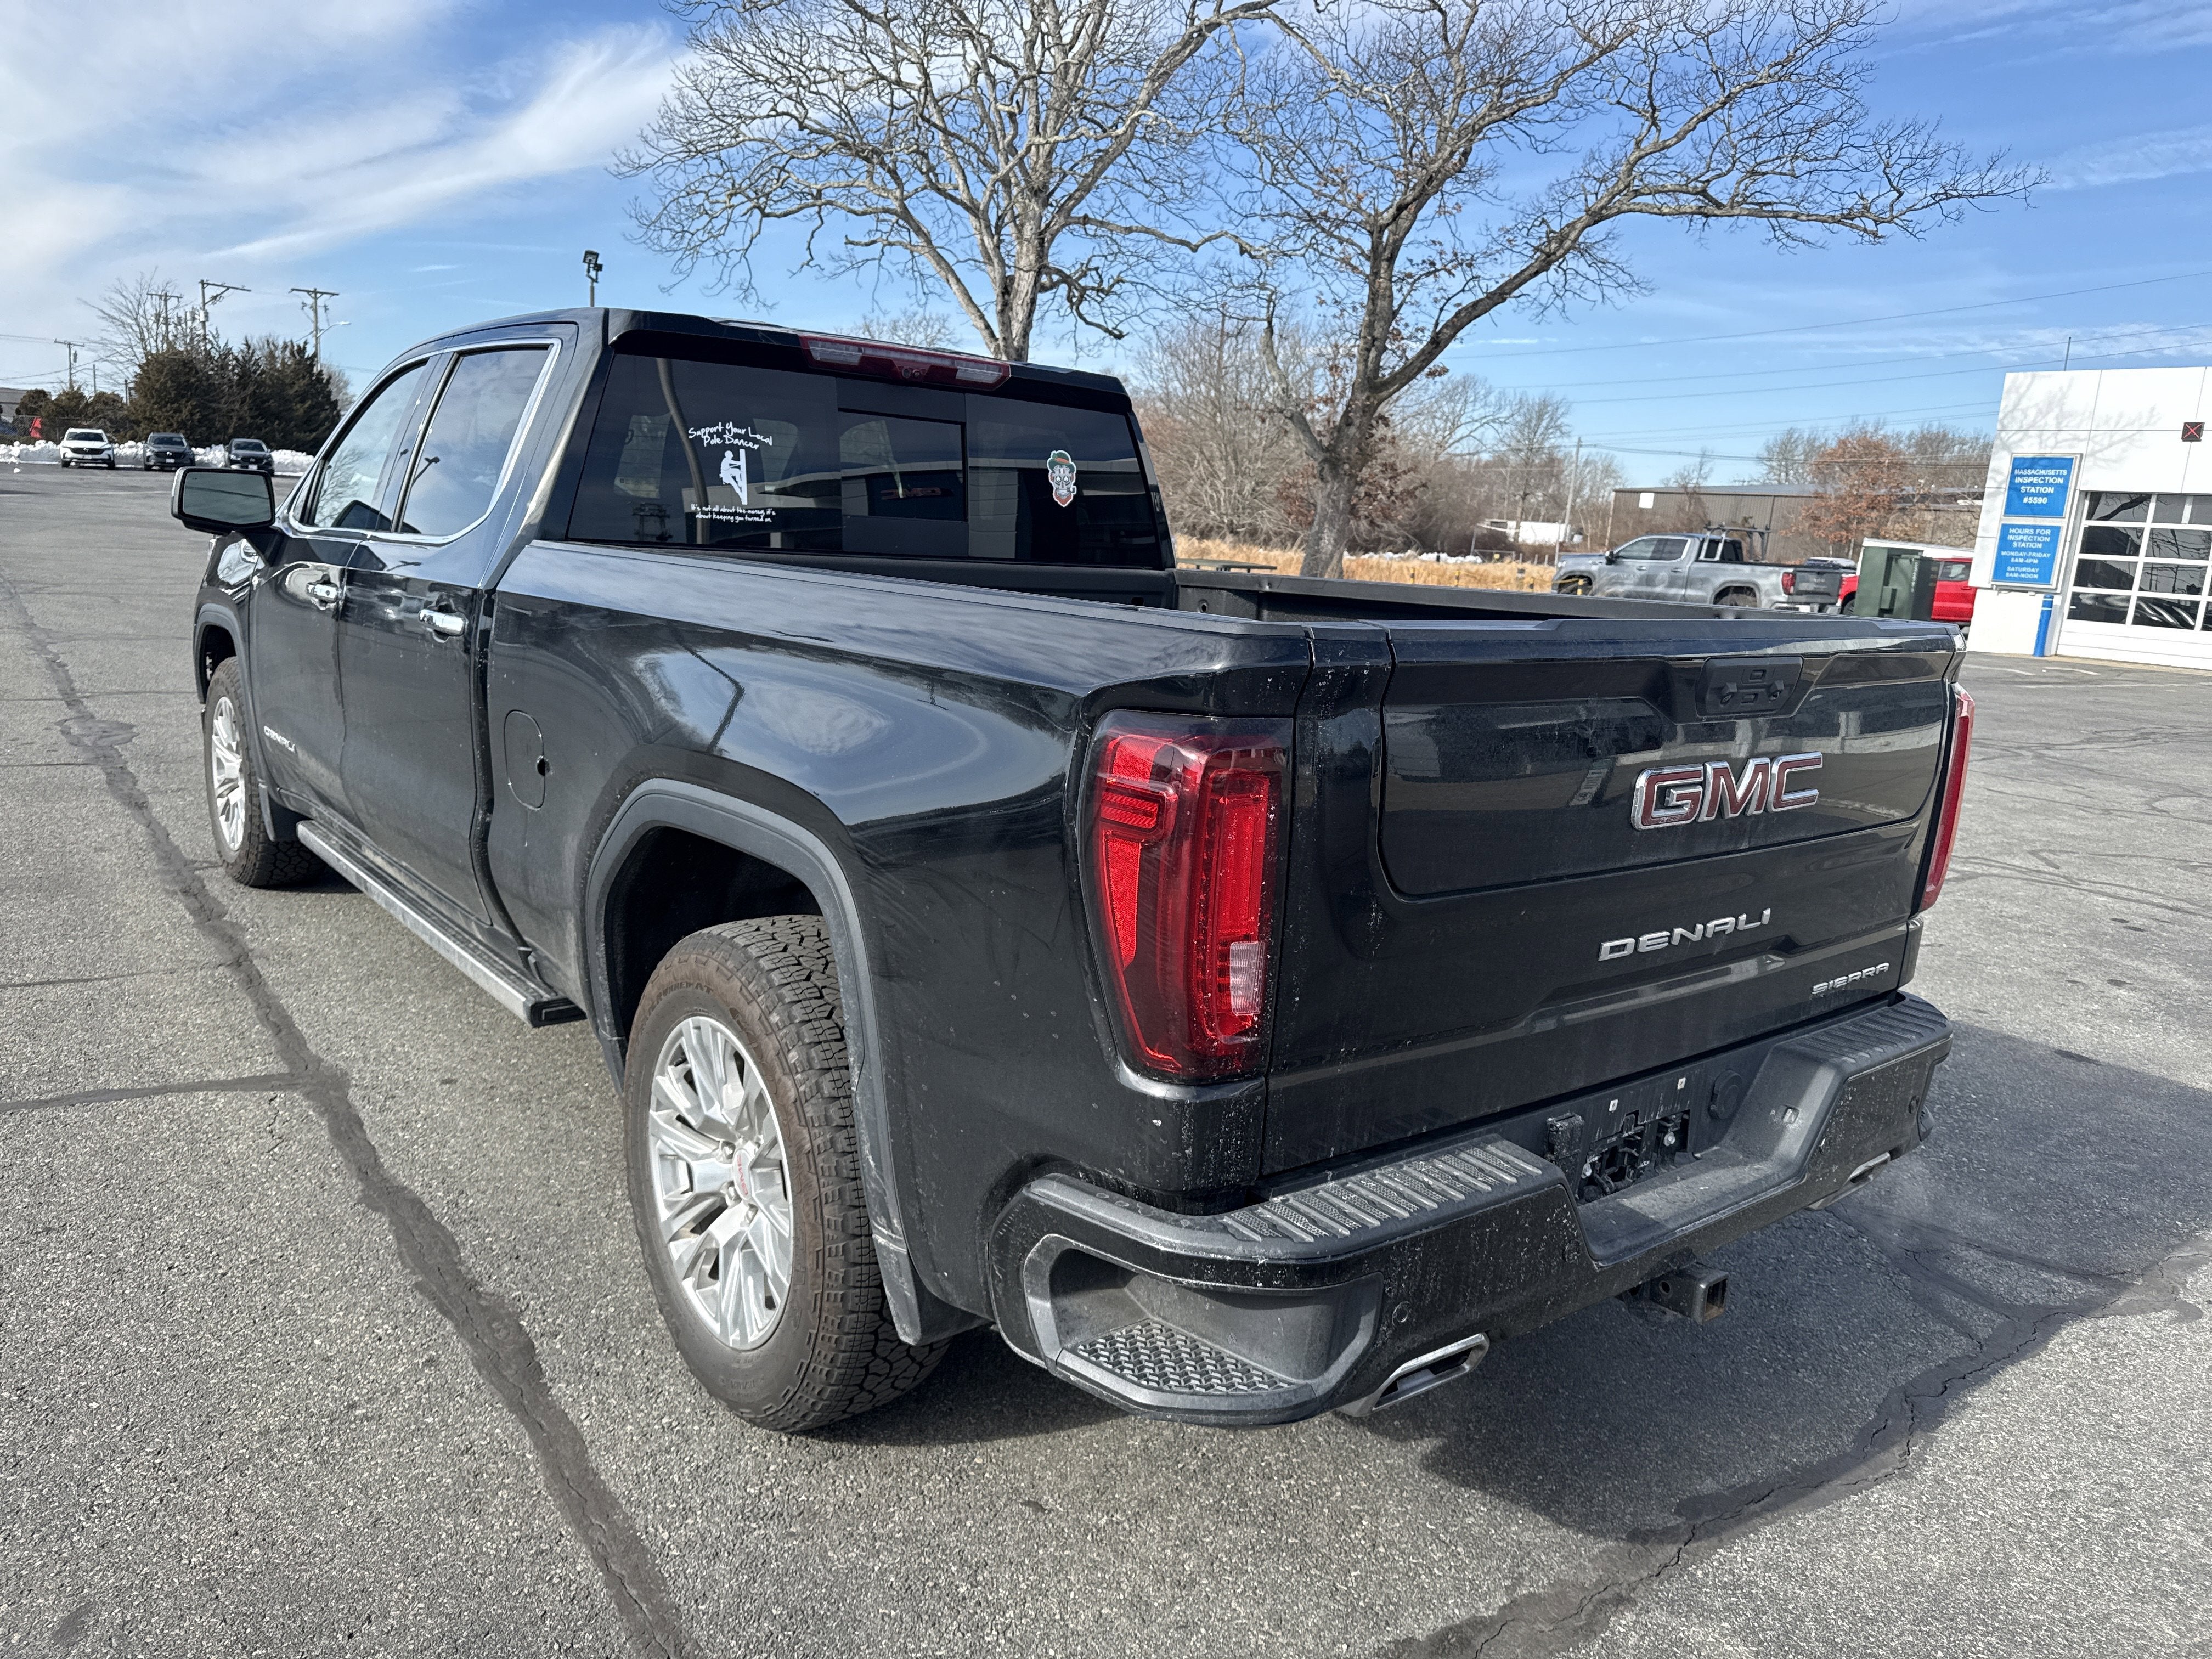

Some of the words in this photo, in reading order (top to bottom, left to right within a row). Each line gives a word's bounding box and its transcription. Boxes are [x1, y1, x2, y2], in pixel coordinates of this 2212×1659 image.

[689, 422, 724, 438] Support
[726, 421, 747, 436] Your
[748, 427, 772, 446] Local
[704, 434, 723, 447] Pole
[723, 435, 759, 449] Dancer
[713, 512, 734, 522] keeping
[1631, 752, 1822, 830] GMC
[1598, 908, 1771, 962] DENALI
[1812, 962, 1889, 995] SIERRA
